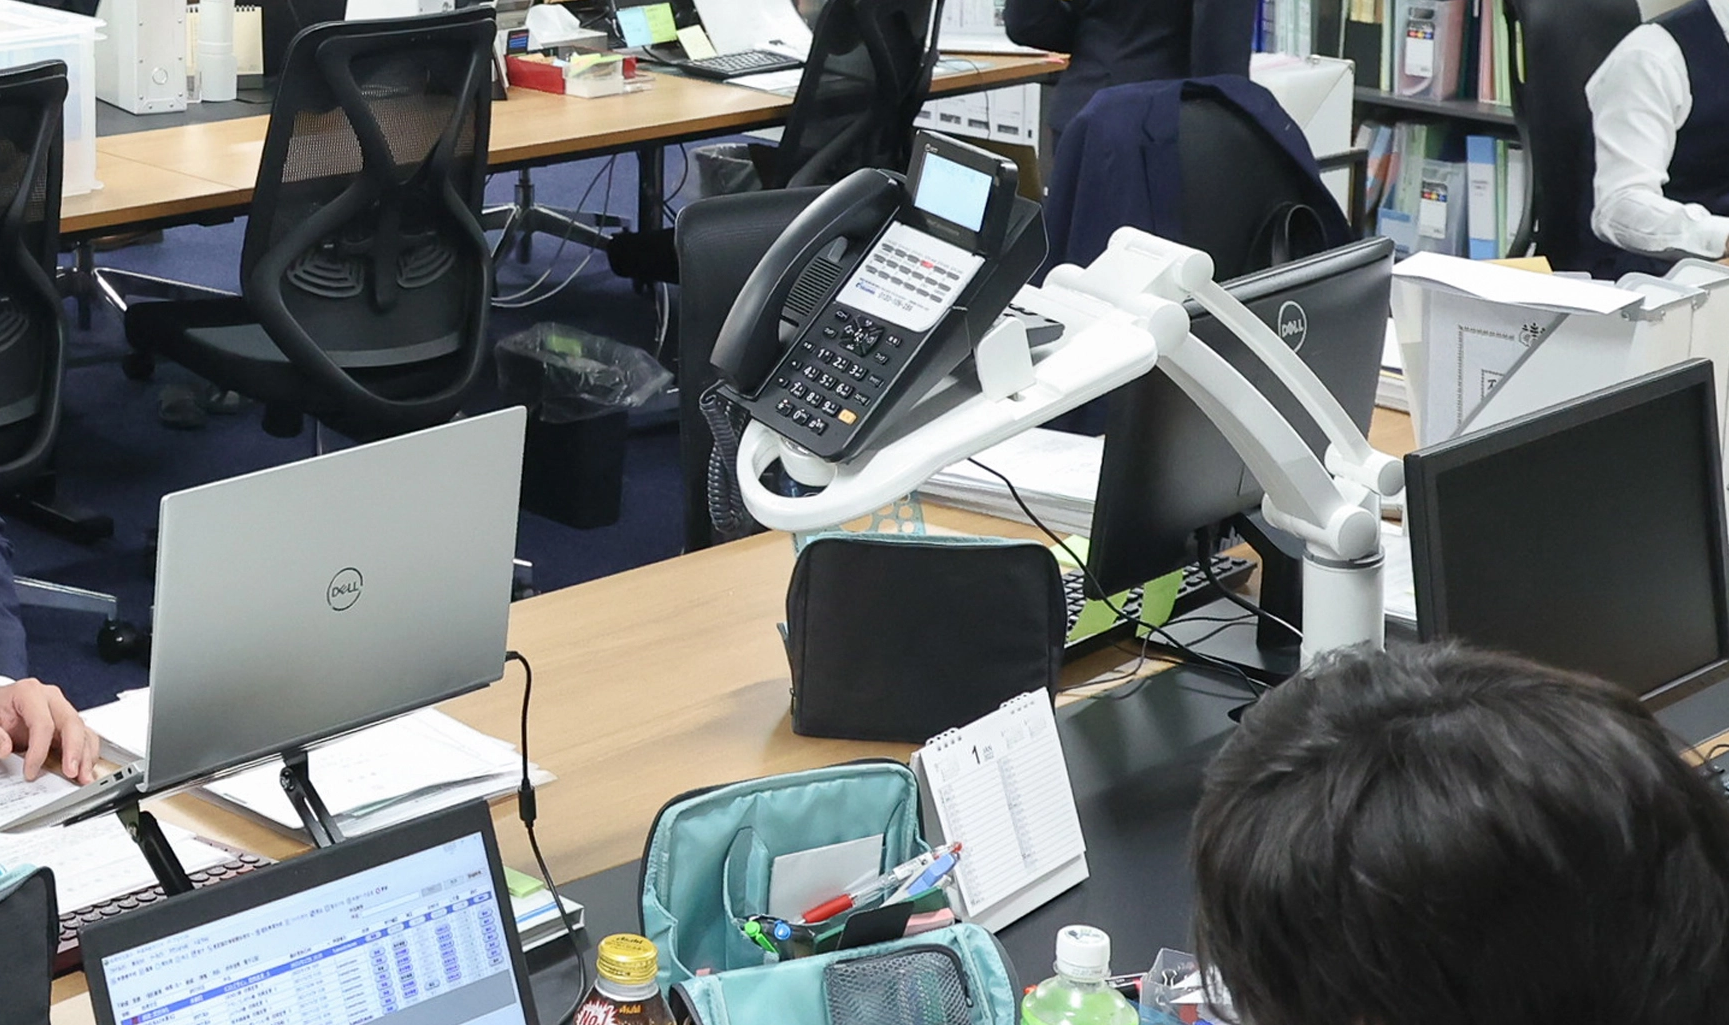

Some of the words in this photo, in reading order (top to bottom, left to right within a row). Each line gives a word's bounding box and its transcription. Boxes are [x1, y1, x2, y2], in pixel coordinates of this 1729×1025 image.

[1281, 318, 1304, 337] DELL
[832, 357, 842, 367] 2
[849, 364, 859, 375] 3
[804, 366, 813, 376] 4
[819, 374, 829, 384] 5
[836, 383, 845, 393] 6
[806, 392, 816, 402] 8
[822, 401, 831, 411] 9
[331, 581, 359, 598] DELL
[971, 744, 981, 765] 1
[619, 1004, 642, 1015] Asahi
